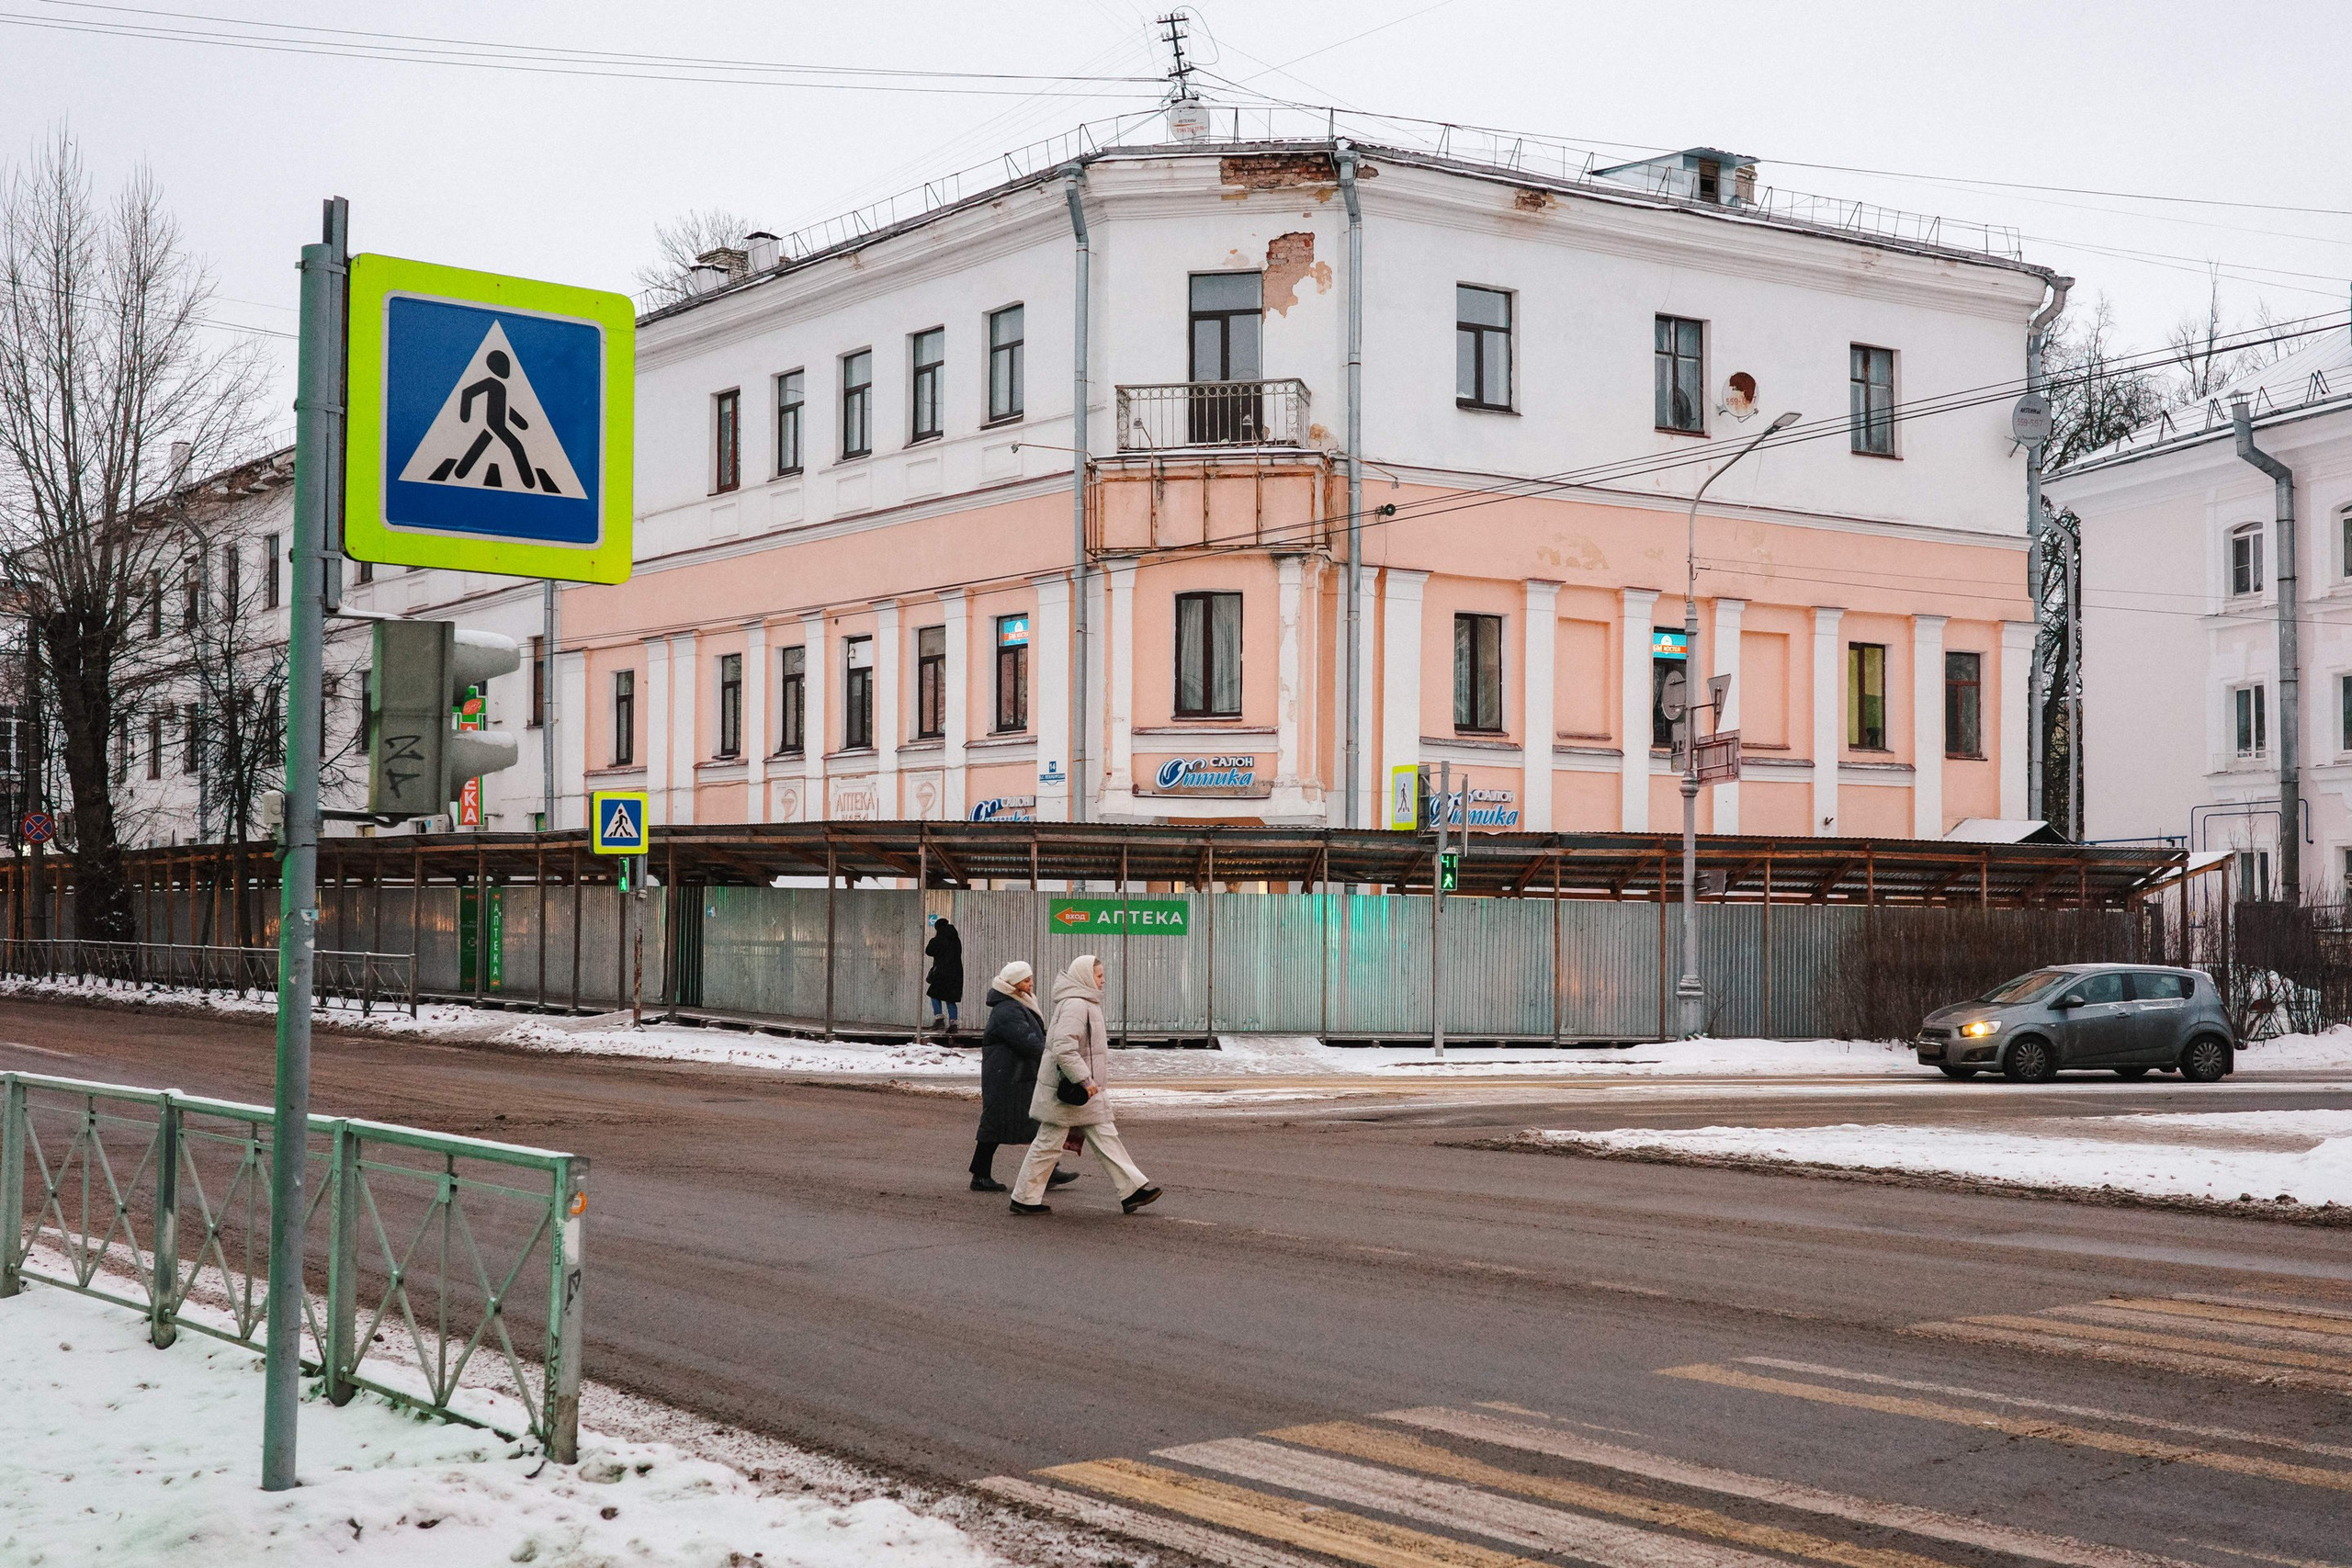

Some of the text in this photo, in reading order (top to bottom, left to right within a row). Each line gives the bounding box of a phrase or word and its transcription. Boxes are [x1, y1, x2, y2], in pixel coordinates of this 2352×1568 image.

[1210, 757, 1253, 767] САЛОН
[1157, 758, 1255, 788] Оптика
[836, 792, 875, 812] АПТЕКА
[1441, 855, 1457, 869] 41
[1096, 910, 1183, 925] АПТЕКА
